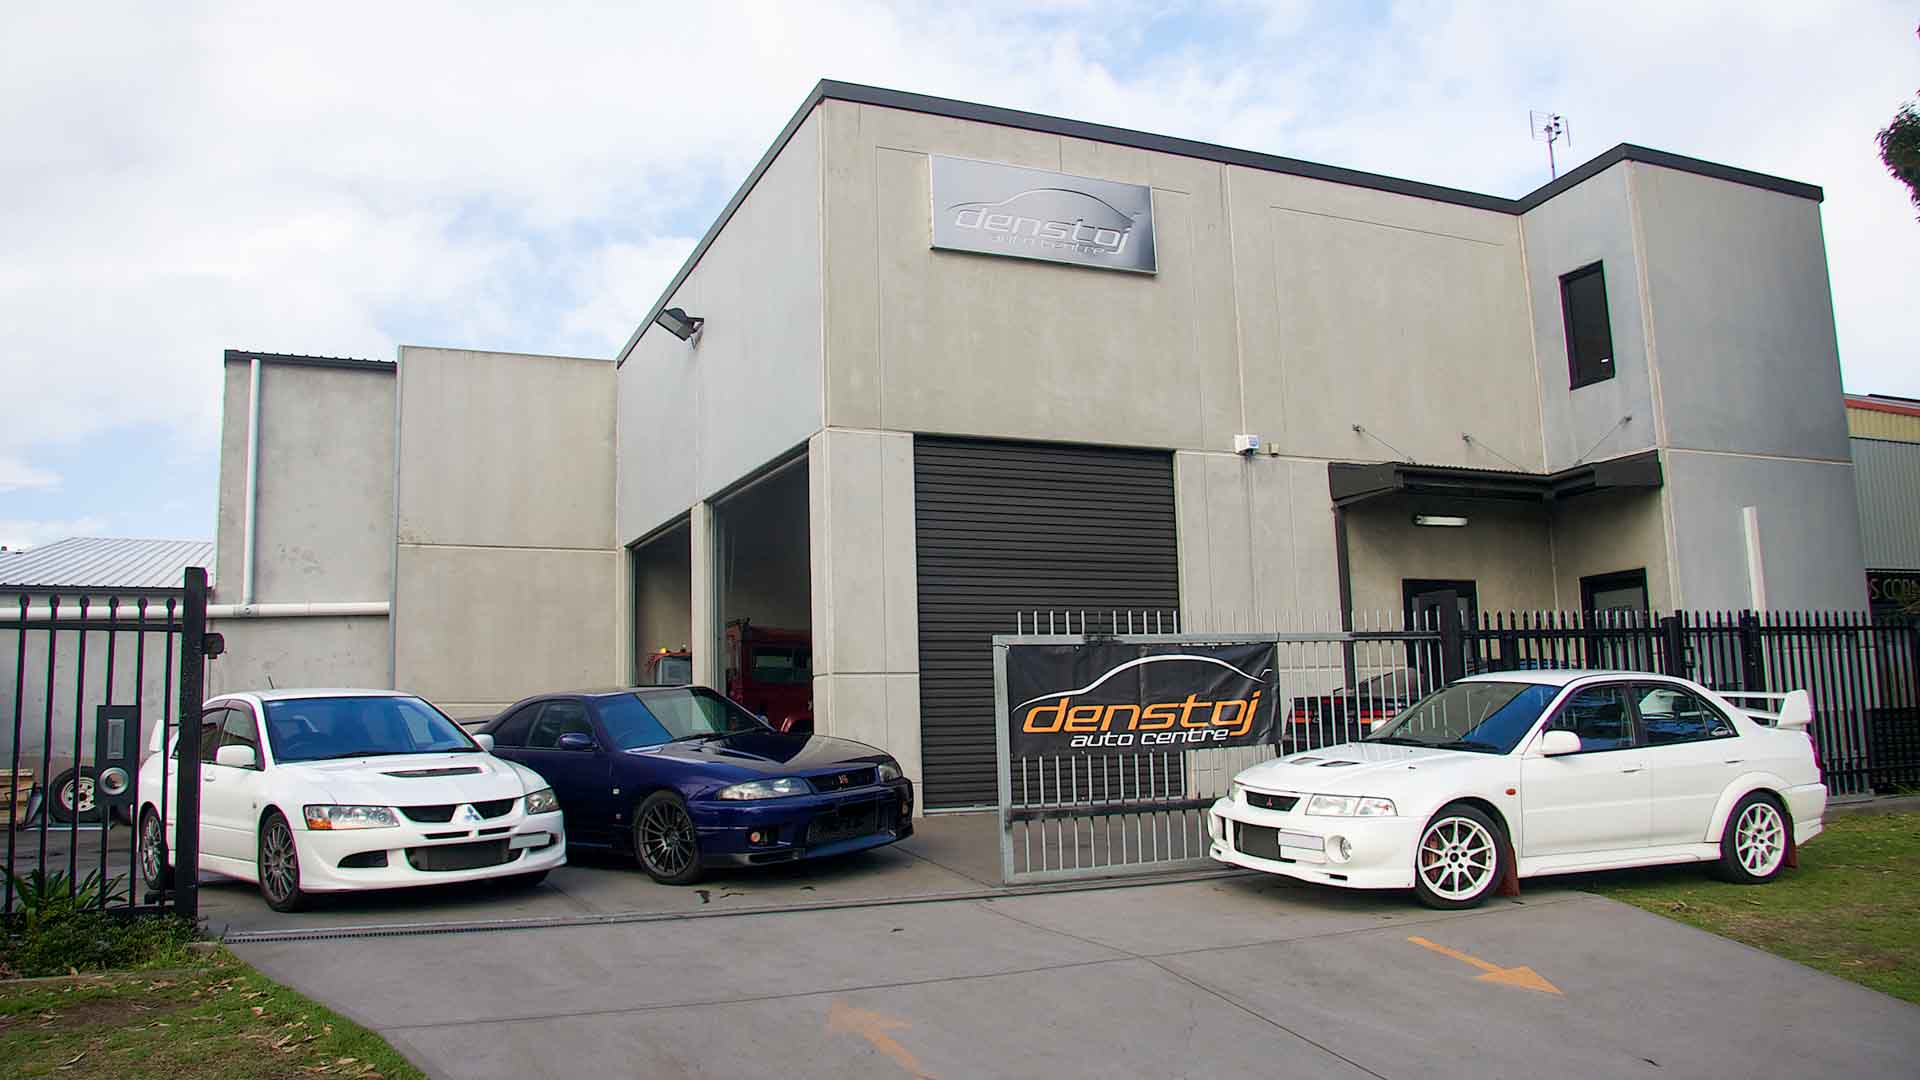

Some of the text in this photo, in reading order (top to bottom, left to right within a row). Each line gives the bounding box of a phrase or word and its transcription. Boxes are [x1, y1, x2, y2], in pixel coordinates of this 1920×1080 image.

[955, 207, 1132, 255] denstoj
[1023, 690, 1261, 736] denstoj
[1070, 727, 1229, 748] auto centre
